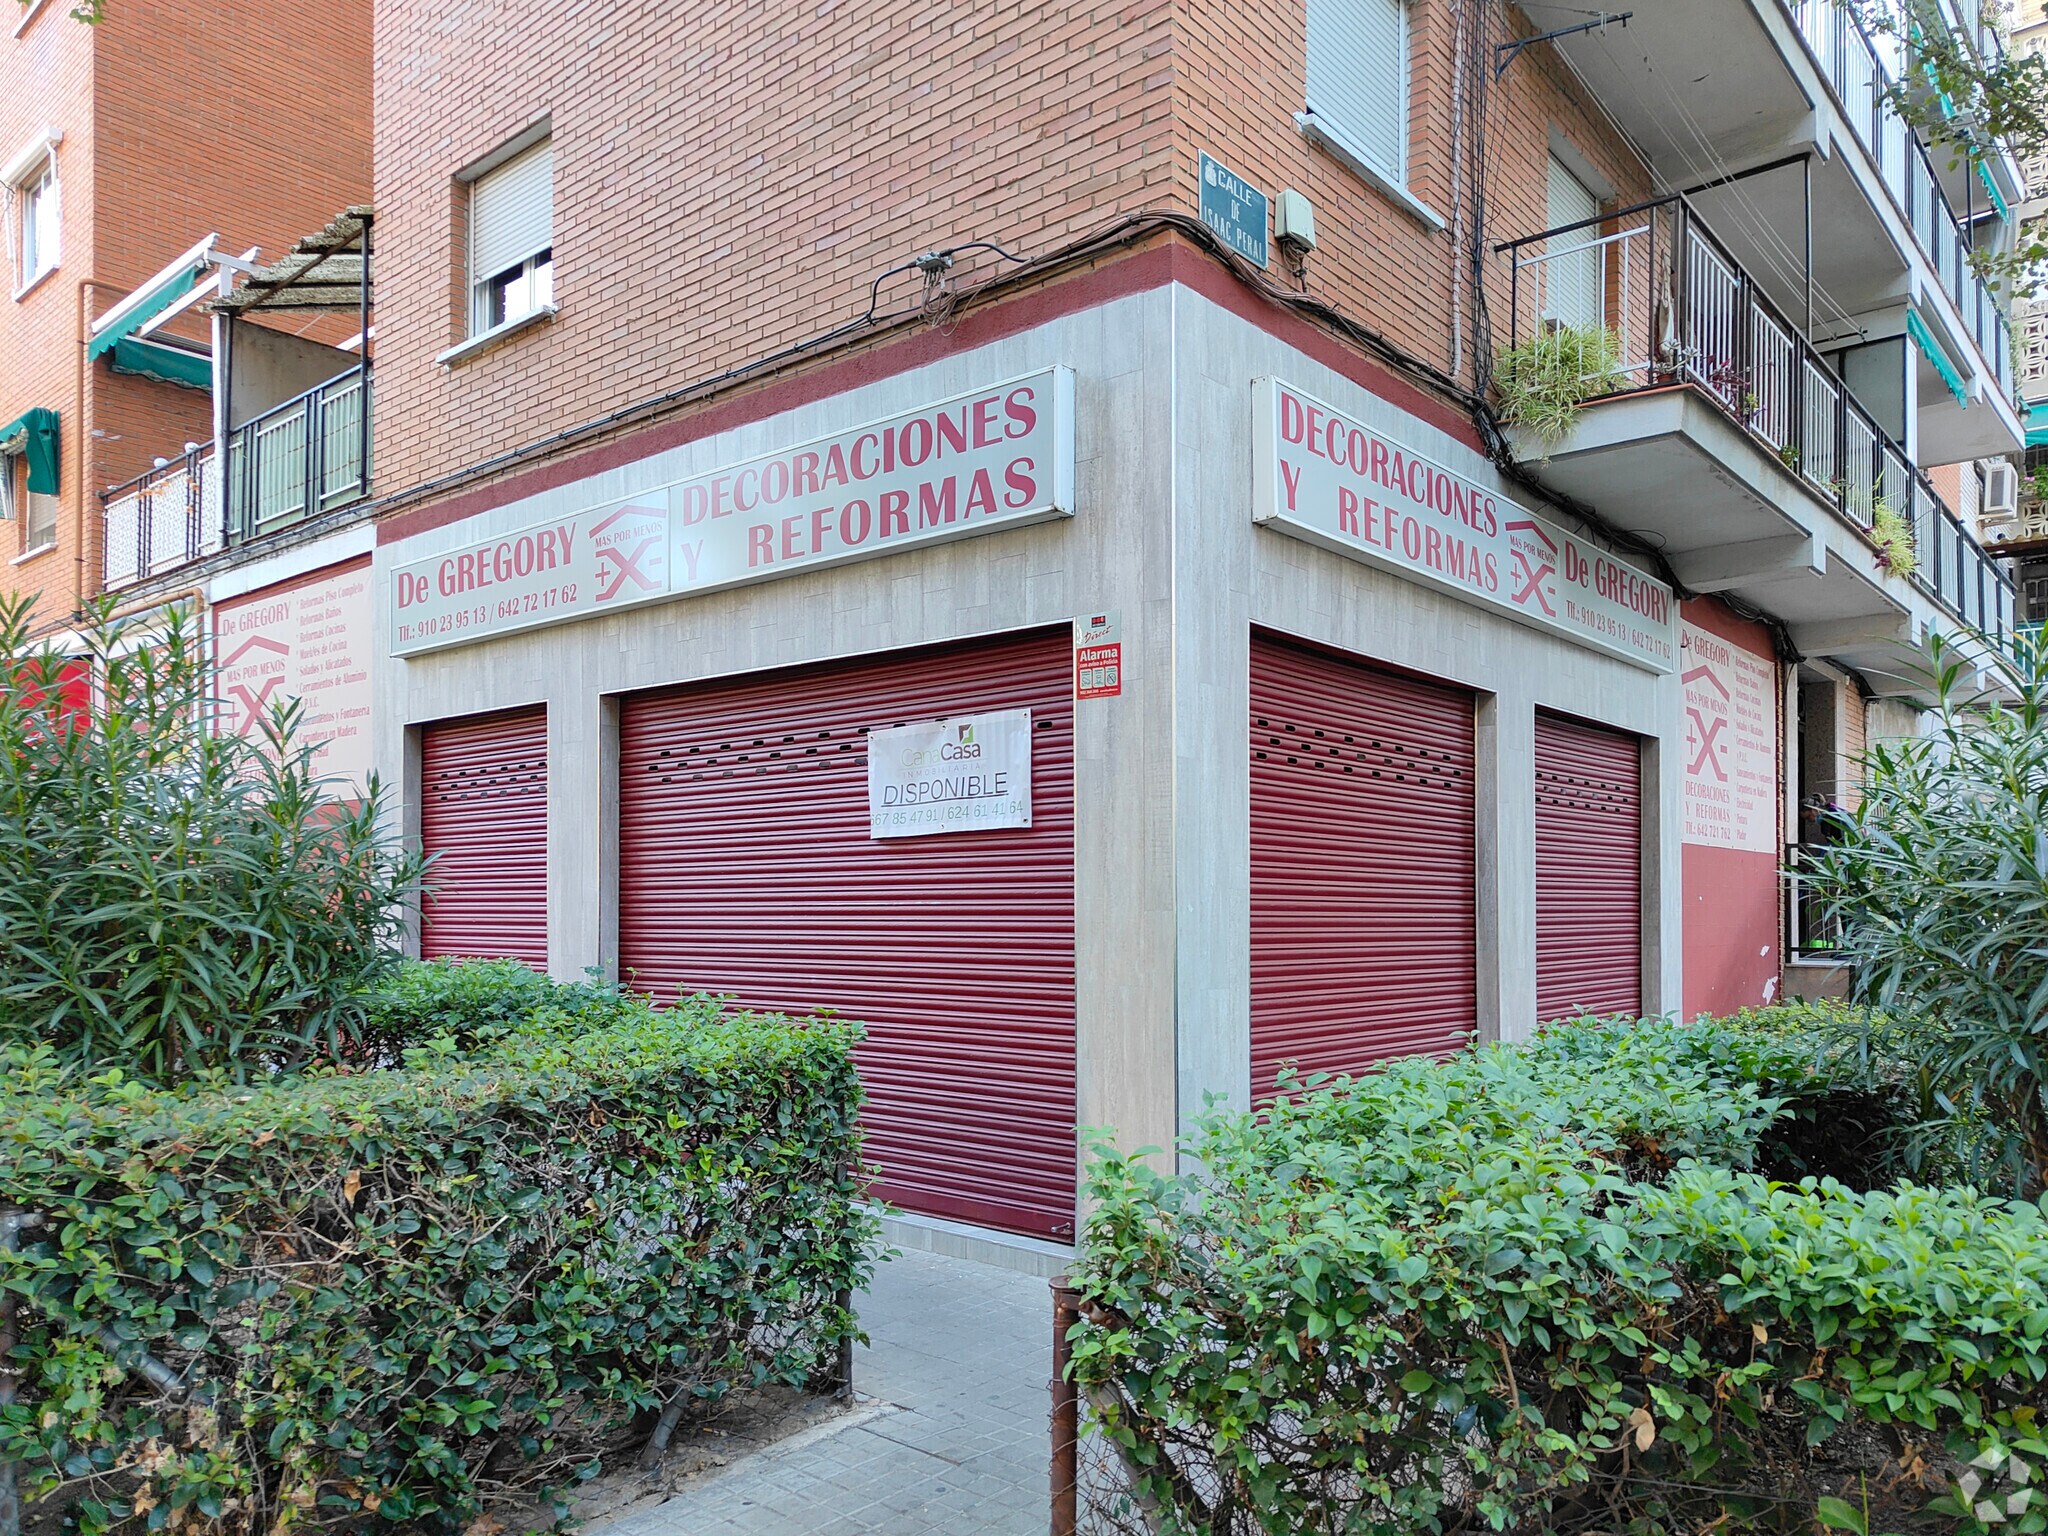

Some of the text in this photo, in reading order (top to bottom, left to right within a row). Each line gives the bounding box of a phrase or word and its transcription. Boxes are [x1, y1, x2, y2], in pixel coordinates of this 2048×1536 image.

[1218, 169, 1252, 207] CALLE
[1231, 199, 1240, 222] DE
[1204, 205, 1263, 261] ISAAC PERAL
[683, 386, 1037, 527] DECORACIONES
[1281, 391, 1498, 538] DECORACIONES
[595, 521, 663, 548] MAS POR MENOS
[681, 456, 1037, 582] Y REFORMAS
[1280, 458, 1498, 593] Y REFORMAS
[398, 522, 577, 609] De GREGORY
[1510, 534, 1555, 565] MAS POR MENOS
[1565, 540, 1669, 626] De GREGORY
[223, 600, 291, 637] De GREGORY
[418, 618, 437, 638] 910
[440, 614, 453, 633] 23
[456, 609, 469, 629] 95
[473, 605, 486, 624] 13
[489, 603, 495, 625] /
[498, 597, 519, 619] 642
[524, 593, 538, 613] 72
[543, 588, 557, 608] 17
[561, 583, 577, 604] 62
[1083, 625, 1114, 644] Direct
[1581, 606, 1595, 628] 910
[1597, 613, 1606, 632] 23
[1607, 618, 1616, 637] 95
[1618, 623, 1626, 641] 13
[1632, 629, 1644, 648] 642
[1645, 634, 1653, 652] 72
[1654, 639, 1661, 656] 17
[1663, 642, 1670, 659] 62
[1681, 629, 1730, 667] De GREGORY
[227, 658, 286, 682] MAS POR MENOS
[1080, 648, 1118, 662] Alarma
[1686, 688, 1728, 716] MAS POR MENOS
[903, 762, 981, 779] INMOBILIARIA
[883, 772, 1008, 804] DISPONIBLE
[1686, 780, 1730, 804] DECORACIONES
[892, 812, 907, 825] 85
[910, 810, 924, 823] 47
[926, 808, 938, 822] 91
[947, 805, 969, 819] 624
[974, 804, 988, 818] 61
[992, 802, 1006, 816] 41
[1009, 800, 1024, 814] 64
[1685, 801, 1730, 823] Y REFORMAS
[1697, 823, 1707, 837] 642
